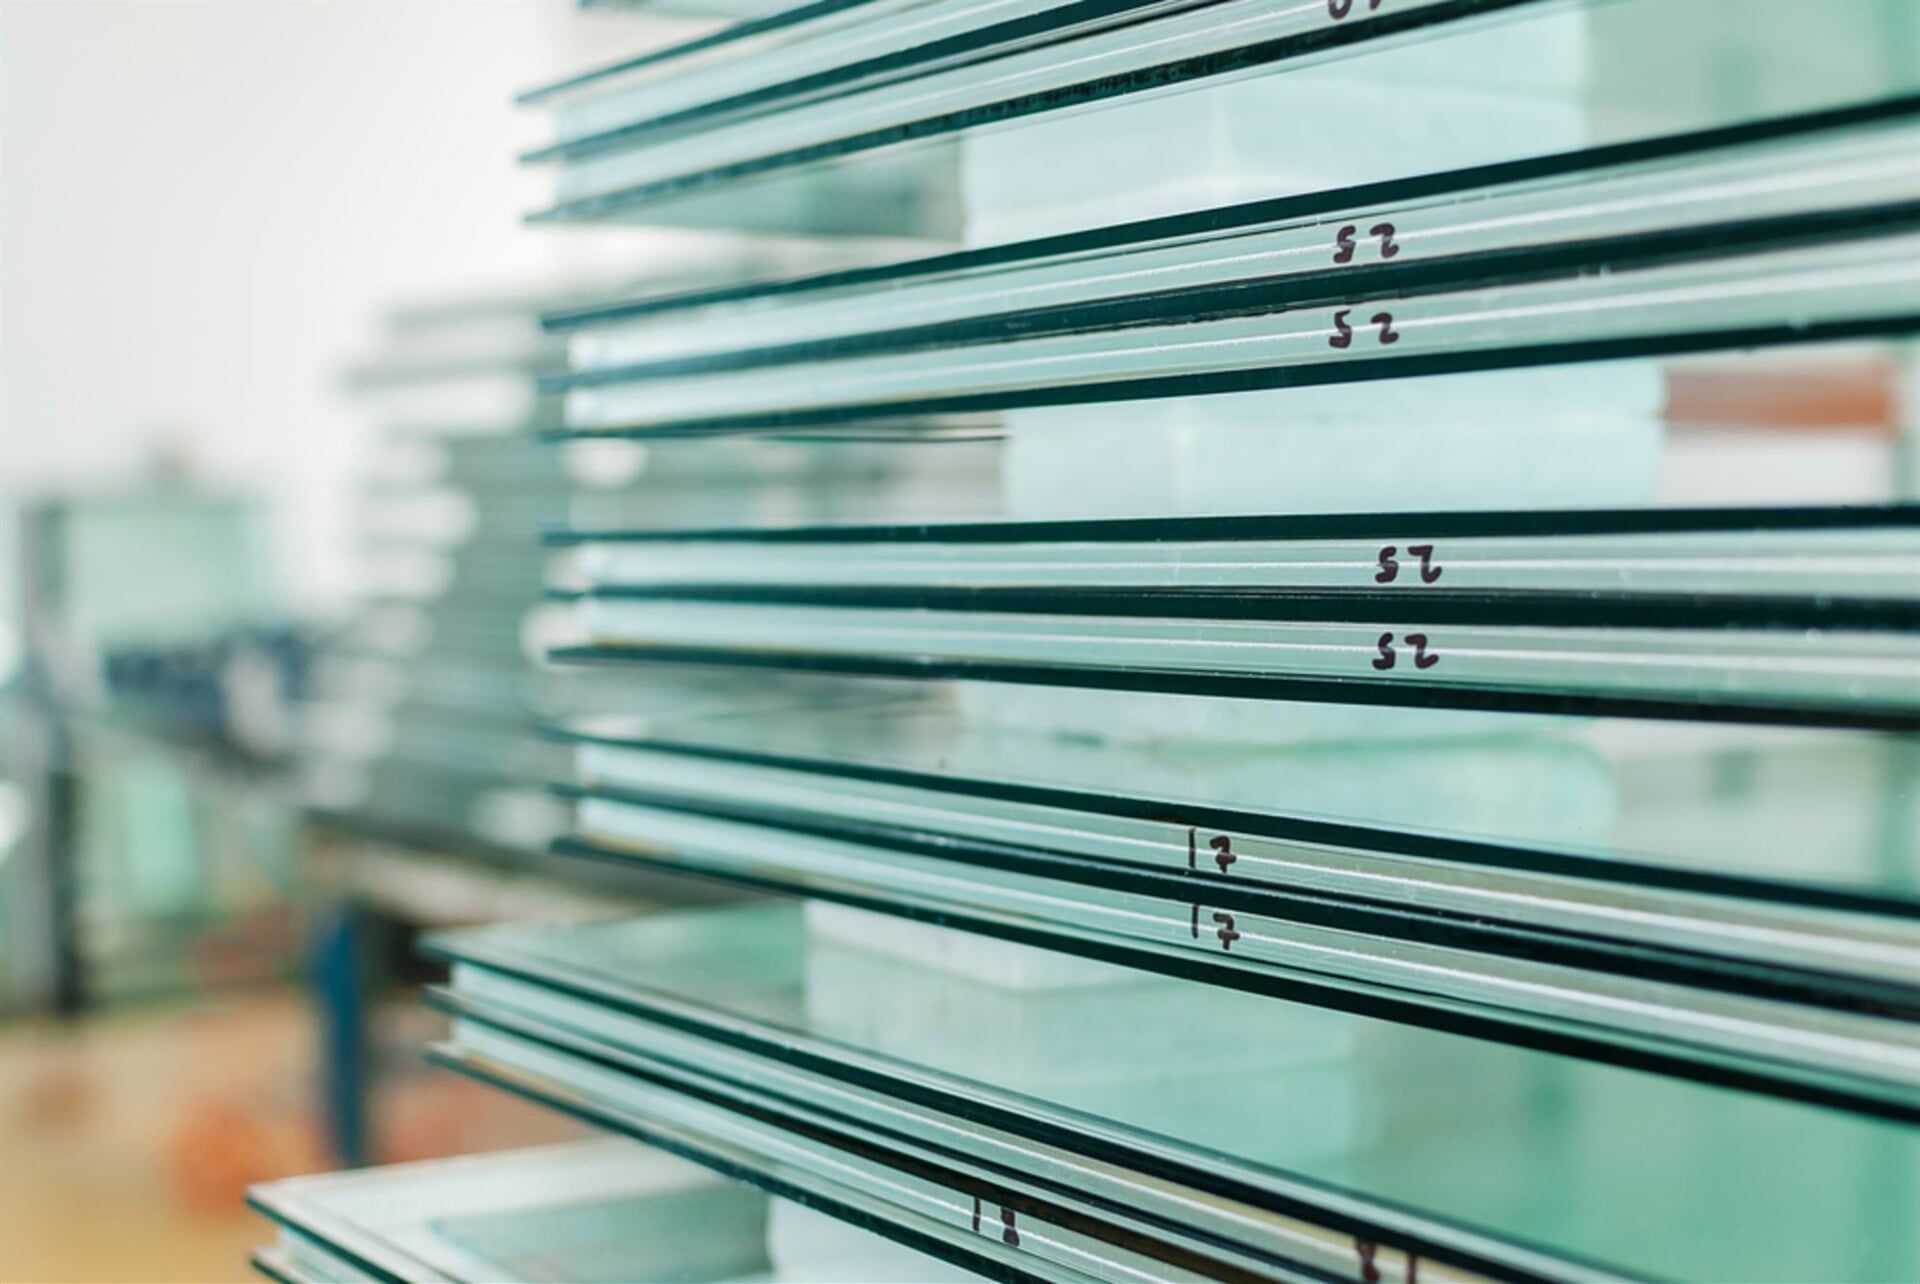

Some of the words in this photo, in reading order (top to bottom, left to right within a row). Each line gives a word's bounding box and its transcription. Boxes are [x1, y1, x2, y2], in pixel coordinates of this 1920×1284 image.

[1333, 222, 1399, 263] 25
[1328, 309, 1399, 349] 25
[1374, 545, 1443, 584] 25
[1371, 632, 1440, 670] 25
